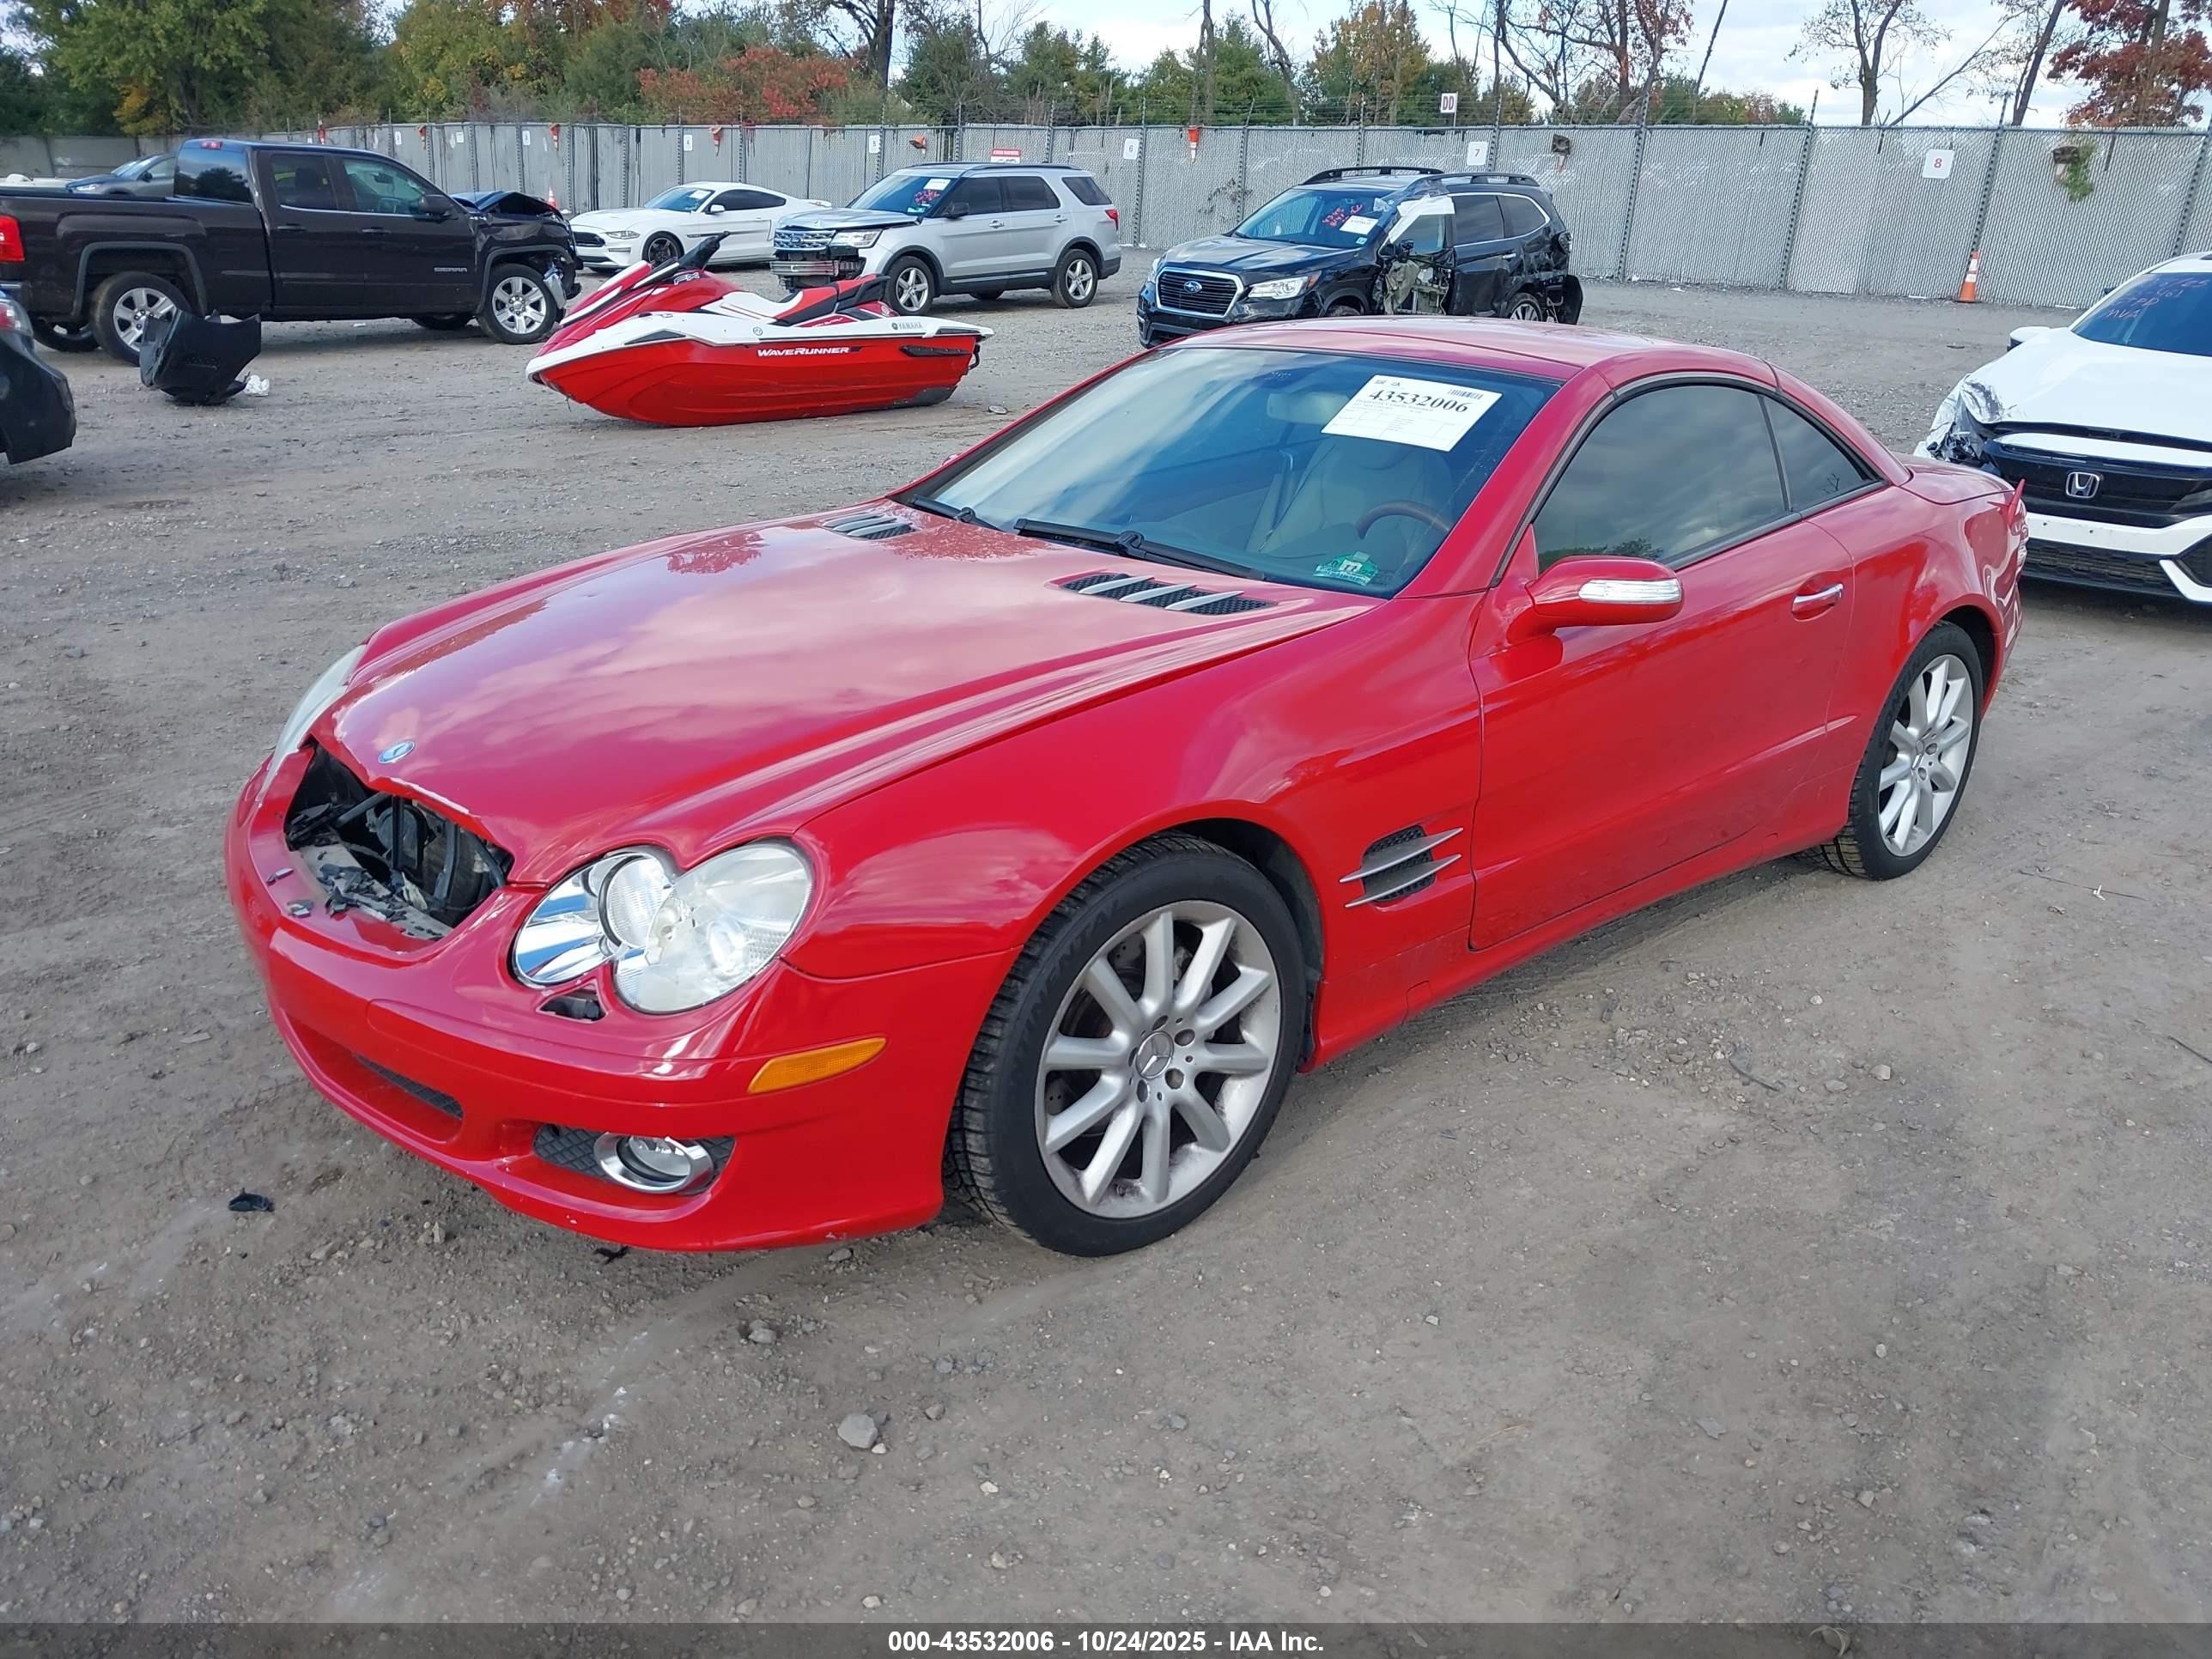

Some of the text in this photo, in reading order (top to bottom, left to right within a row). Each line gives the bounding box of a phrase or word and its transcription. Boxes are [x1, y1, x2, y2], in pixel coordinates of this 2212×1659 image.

[1442, 94, 1455, 112] DD
[1474, 148, 1481, 157] 7
[1933, 157, 1943, 168] 8
[1369, 389, 1472, 413] 43532006
